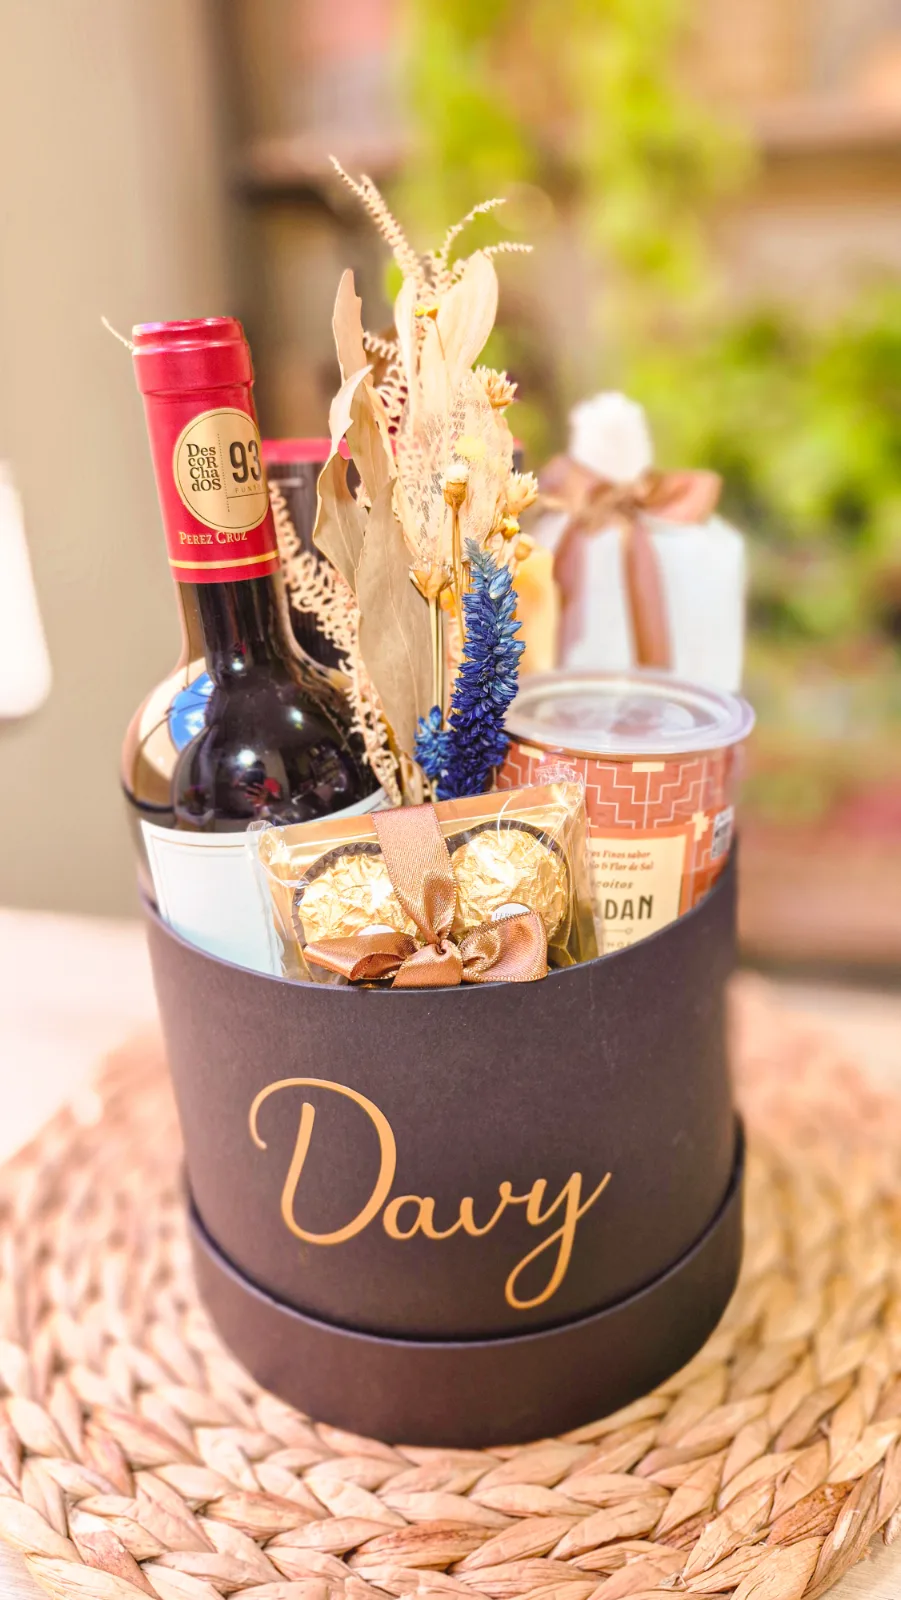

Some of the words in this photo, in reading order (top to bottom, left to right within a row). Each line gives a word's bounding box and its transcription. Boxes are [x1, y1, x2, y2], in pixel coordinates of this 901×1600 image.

[186, 443, 217, 457] Des
[229, 440, 262, 484] 93
[189, 467, 220, 480] Cha
[179, 531, 214, 545] PEREZ
[216, 531, 248, 544] CRUZ
[627, 849, 652, 860] sabor
[640, 860, 654, 871] Sal
[595, 878, 634, 889] coitos
[603, 894, 654, 920] DAN
[248, 1077, 613, 1309] Davy
